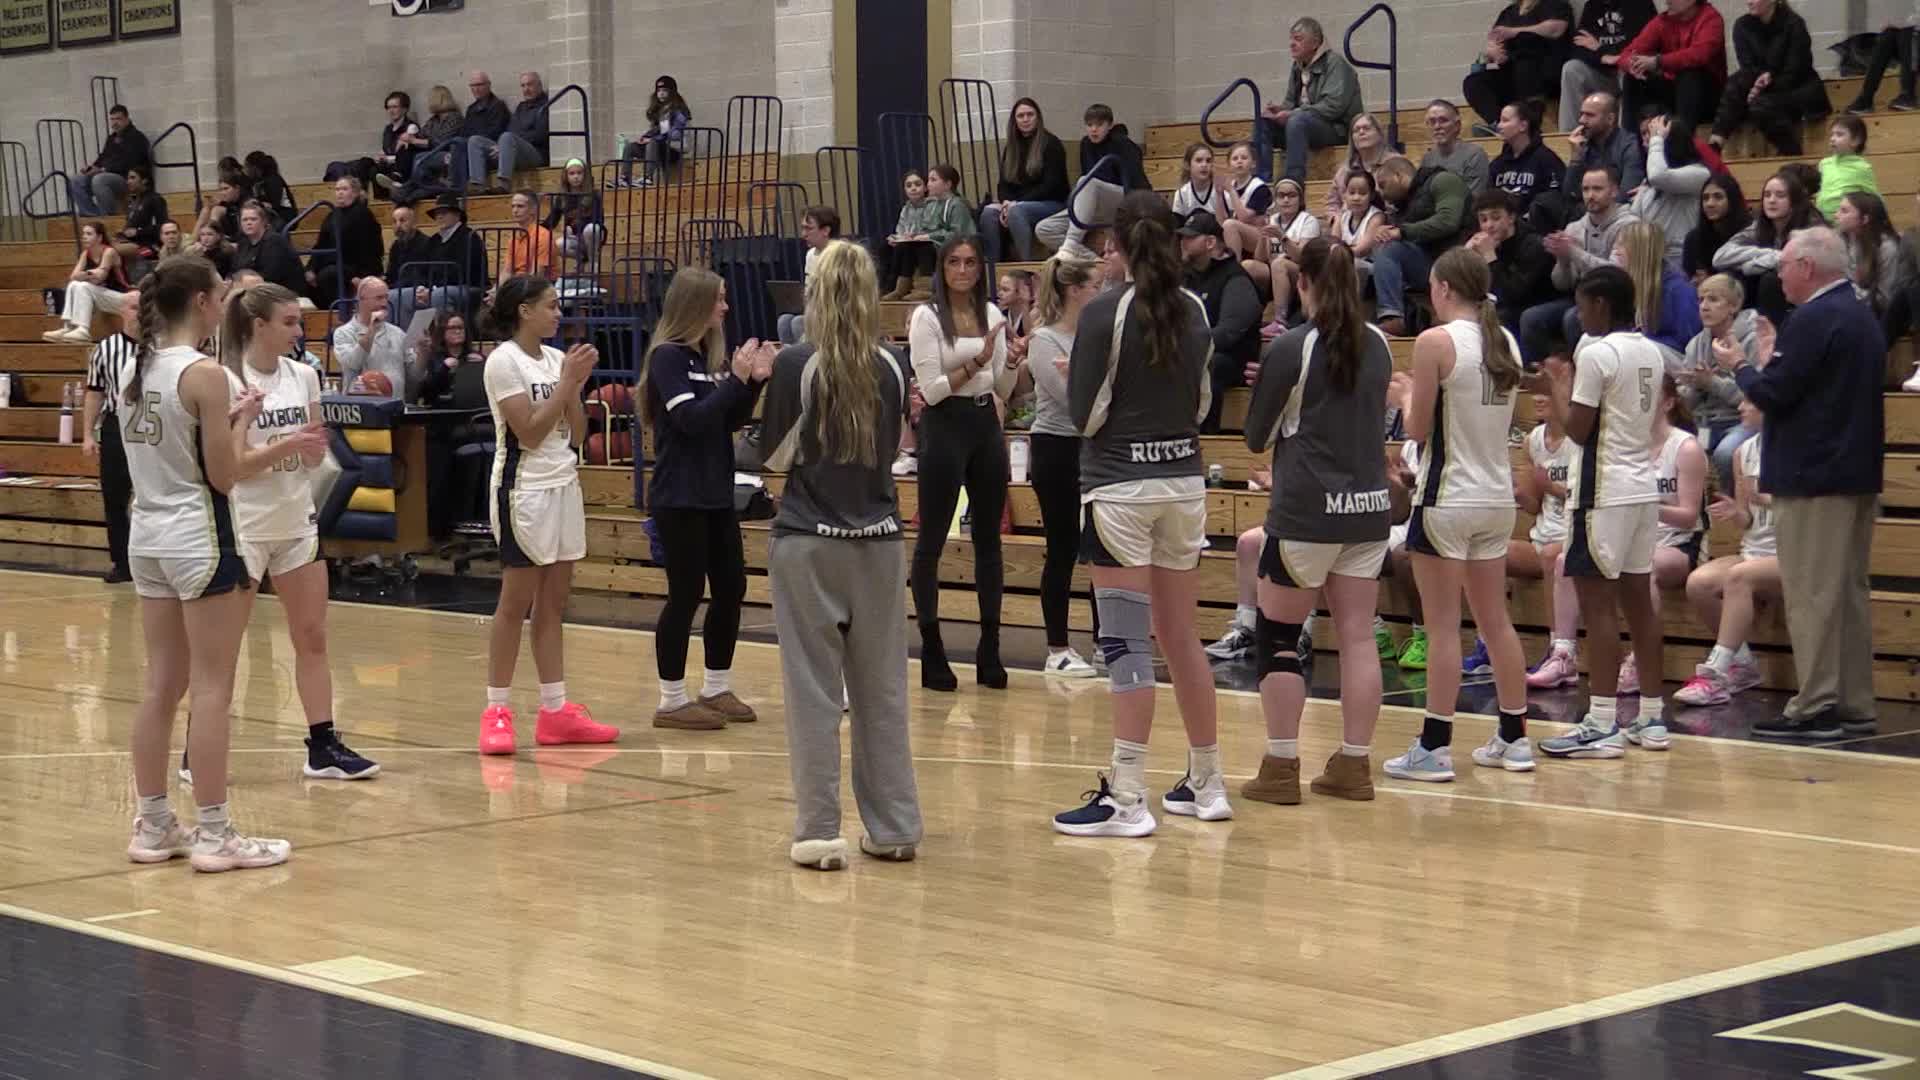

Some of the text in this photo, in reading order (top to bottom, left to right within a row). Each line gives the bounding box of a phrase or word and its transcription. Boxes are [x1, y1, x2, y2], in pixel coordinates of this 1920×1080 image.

[61, 15, 108, 31] CHAMPIONS
[124, 4, 173, 23] CHAMPIONS
[1, 22, 46, 39] CHAMPIONS
[1638, 367, 1653, 413] 5
[125, 391, 162, 446] 25
